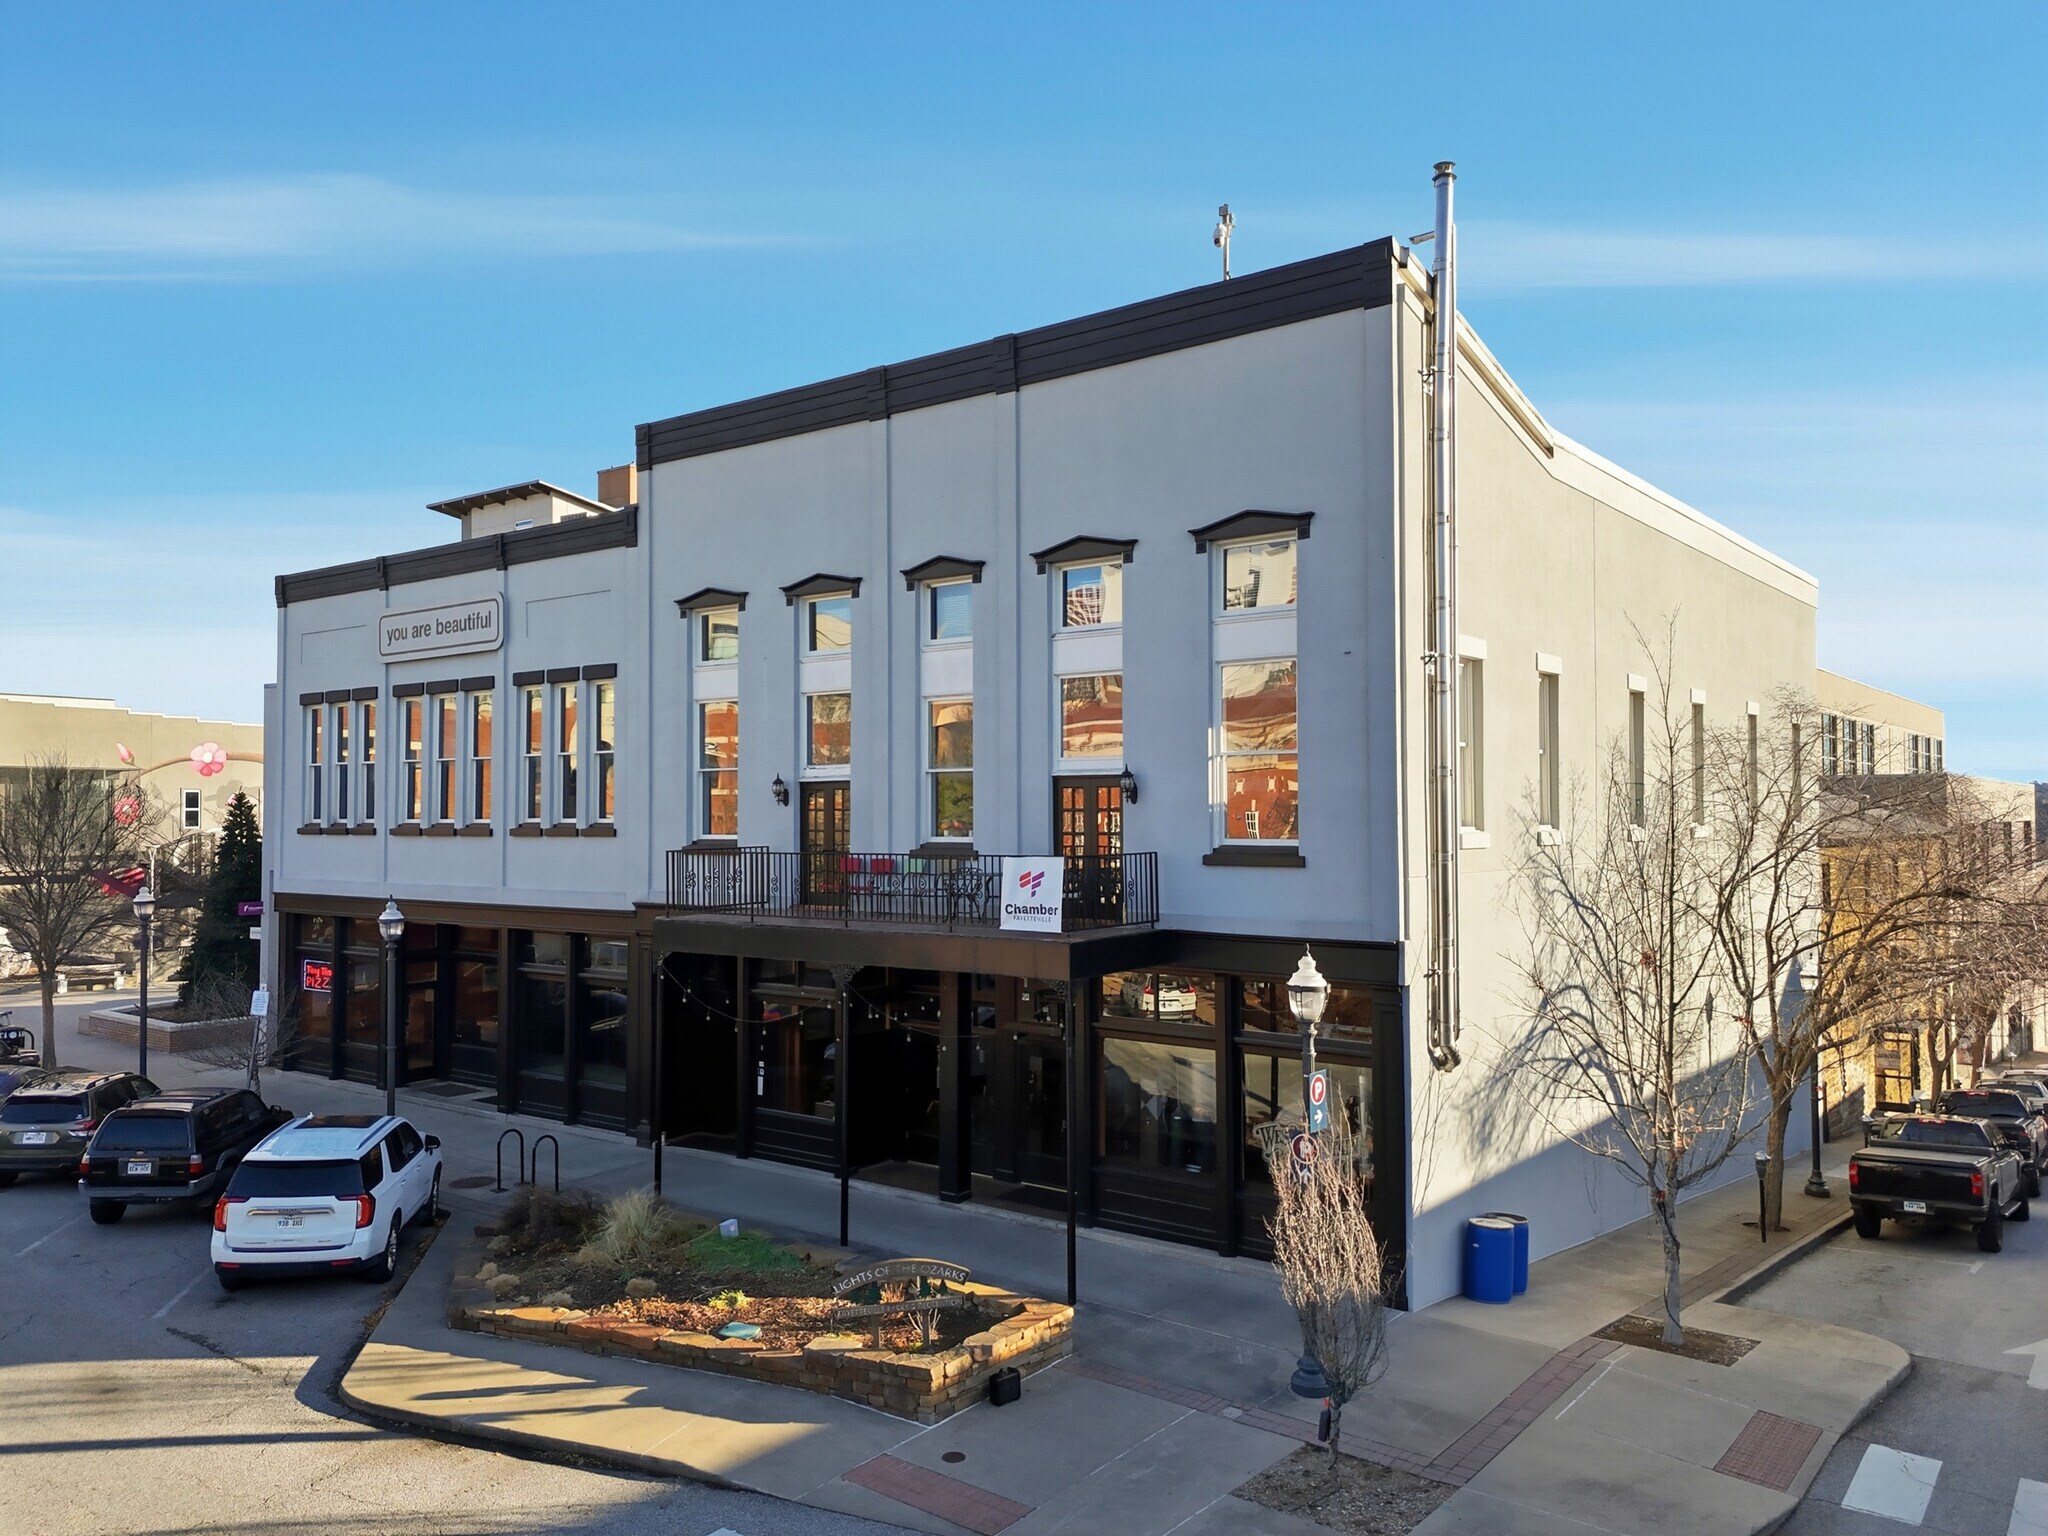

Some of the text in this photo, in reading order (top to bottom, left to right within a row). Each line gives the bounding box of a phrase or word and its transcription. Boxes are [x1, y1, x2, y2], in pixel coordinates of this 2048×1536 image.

[386, 610, 491, 647] you are beautiful
[1005, 903, 1058, 916] Chamber
[306, 976, 331, 988] PIZZ
[1314, 1081, 1323, 1100] P
[832, 1270, 873, 1294] LIGHTS
[874, 1266, 890, 1277] OF
[920, 1264, 967, 1281] OZARKS
